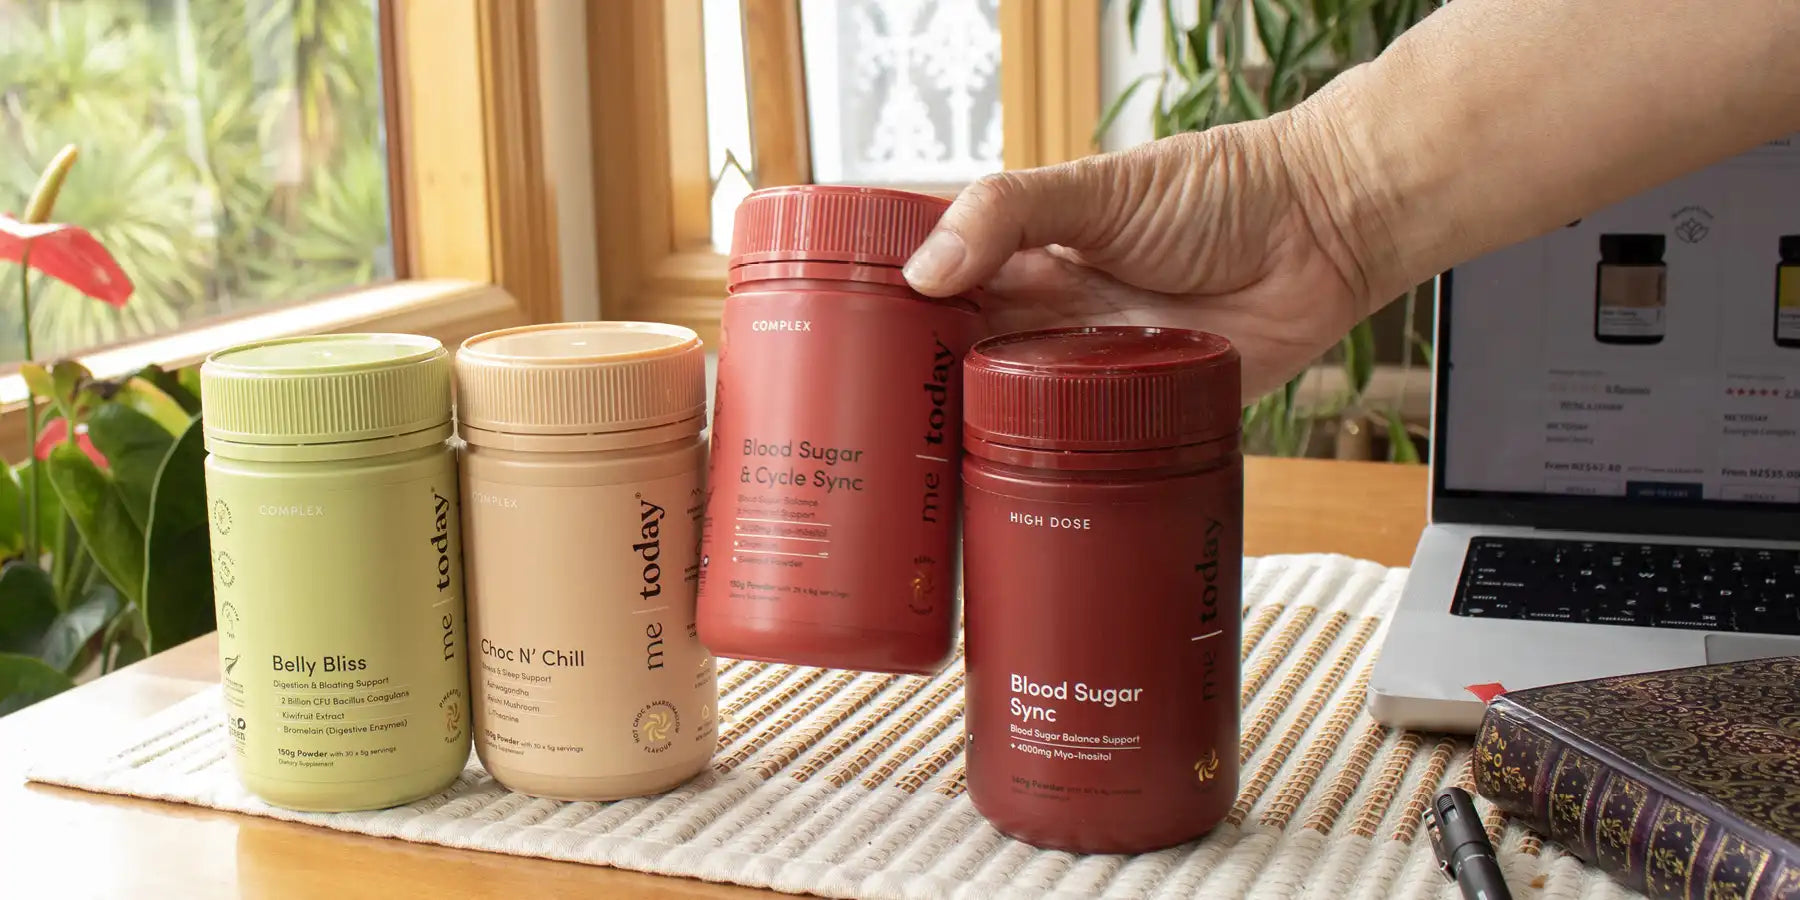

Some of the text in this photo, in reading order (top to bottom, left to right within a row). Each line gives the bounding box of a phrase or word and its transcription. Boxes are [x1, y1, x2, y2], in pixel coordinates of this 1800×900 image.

[752, 320, 812, 331] COMPLEX
[922, 339, 955, 523] me today
[743, 438, 863, 466] Blood Sugar
[741, 466, 864, 493] & Cycle Sync
[259, 504, 325, 516] COMPLEX
[1010, 511, 1091, 530] HIGH DOSE
[442, 612, 455, 661] me
[481, 638, 514, 662] Choc
[542, 650, 585, 667] Chill
[646, 622, 664, 671] me
[272, 655, 368, 676] Belly Bliss
[273, 679, 310, 690] Digestion
[319, 681, 354, 690] Bloating
[356, 677, 389, 688] Support
[521, 672, 552, 683] Support
[287, 697, 312, 706] Billion
[313, 698, 331, 706] CFU
[333, 696, 365, 705] Bacillus
[367, 690, 410, 703] Coagulans
[1010, 674, 1143, 707] Blood Sugar
[282, 711, 345, 720] Kiwifruit Extract
[503, 700, 540, 713] Mushroom
[1010, 698, 1057, 723] Sync
[284, 718, 408, 736] Bromelain (Digestive Enzymes)
[633, 708, 646, 727] CHOC
[1010, 724, 1140, 746] Blood Sugar Balance Support
[278, 748, 295, 758] 150g
[1017, 743, 1112, 761] 4000mg Myo-Inositol
